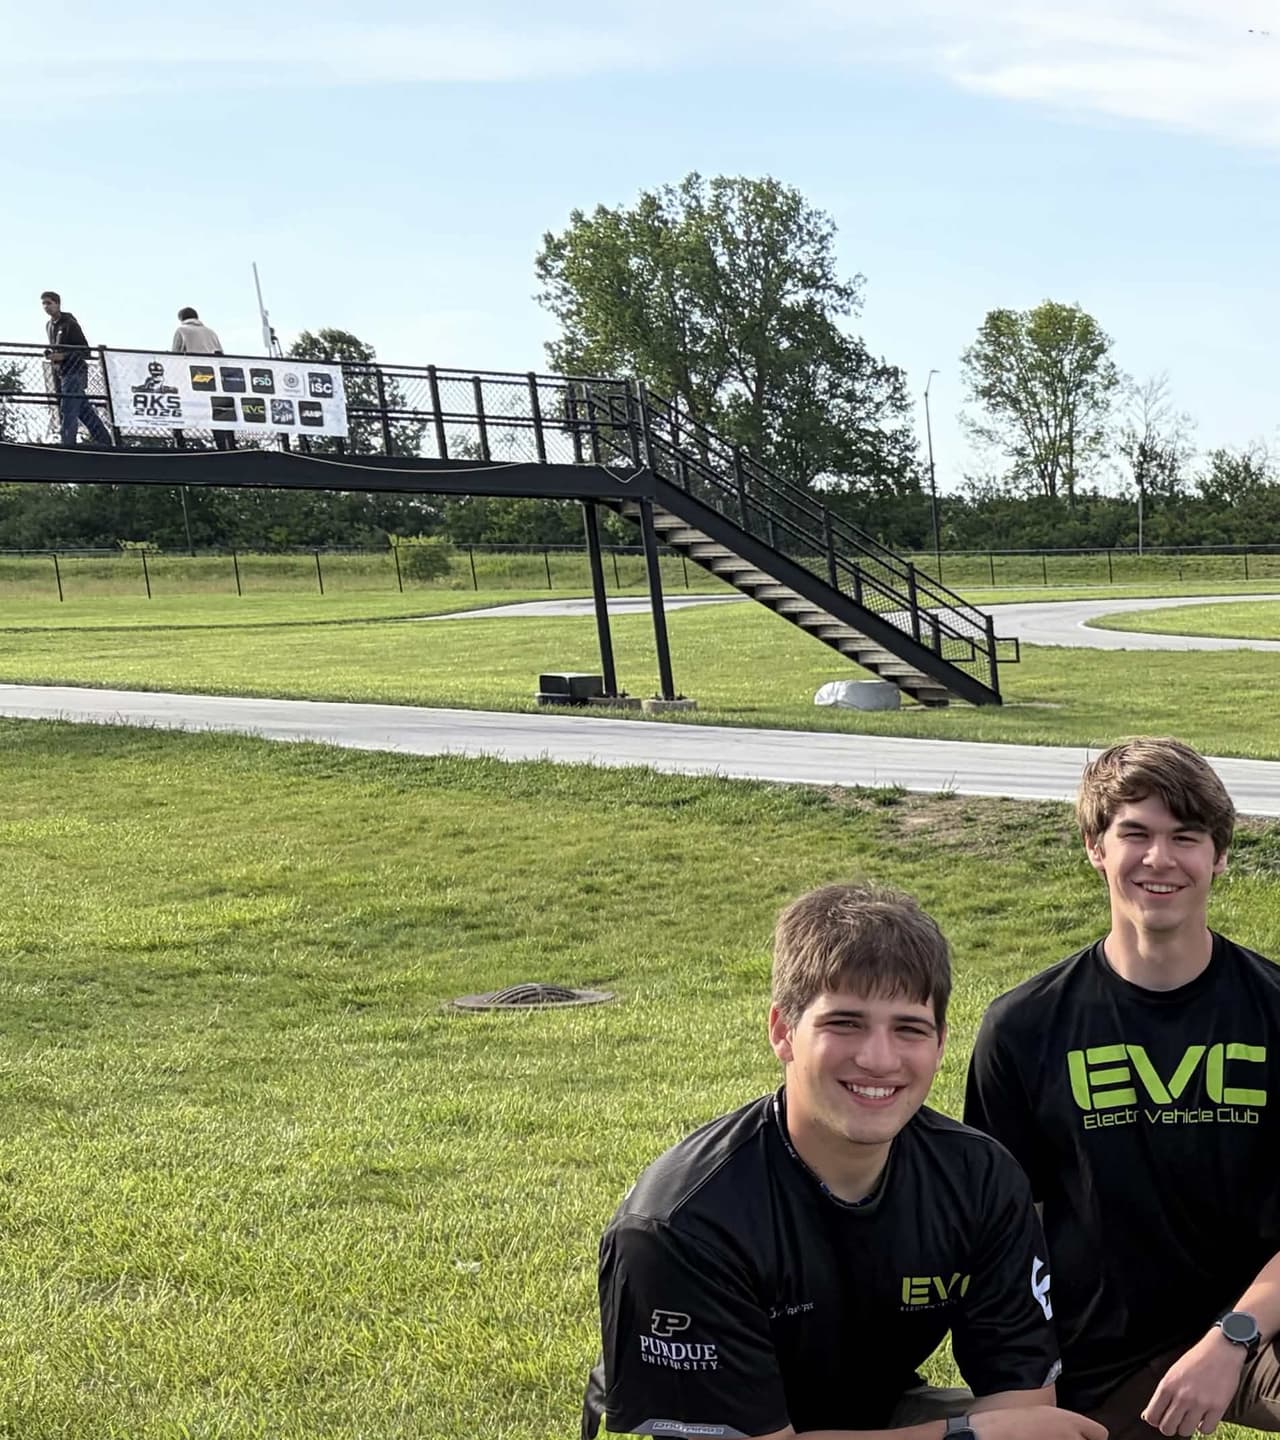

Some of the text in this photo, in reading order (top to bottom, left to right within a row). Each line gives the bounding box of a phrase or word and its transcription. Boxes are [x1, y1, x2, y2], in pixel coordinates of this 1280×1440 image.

[311, 383, 332, 393] ISC
[1067, 1043, 1267, 1111] EVC
[1083, 1107, 1259, 1130] Electr Vehicle Club
[639, 1335, 718, 1360] PURDUE
